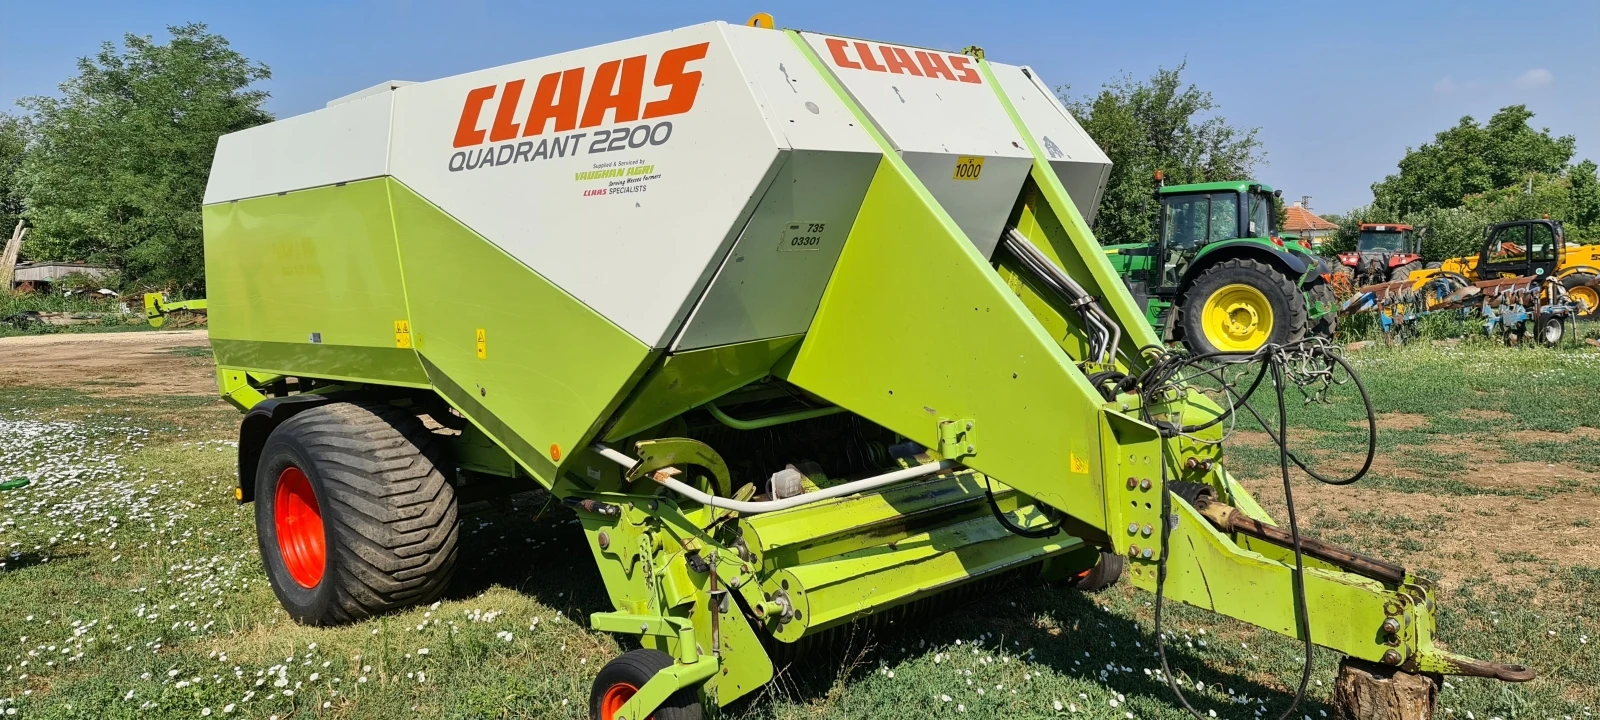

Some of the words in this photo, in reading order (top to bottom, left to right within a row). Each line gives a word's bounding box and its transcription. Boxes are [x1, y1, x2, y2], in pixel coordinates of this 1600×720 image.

[825, 38, 982, 84] CLAAS
[453, 41, 710, 148] CLAAS
[448, 133, 587, 172] QUADRANT
[588, 121, 673, 154] 2200
[575, 167, 625, 181] VAUGHAN
[626, 165, 655, 176] AGRI
[955, 163, 981, 178] 1000
[608, 179, 625, 187] Serving
[583, 188, 607, 197] CLAAS
[608, 185, 647, 195] SPECIALISTS
[807, 223, 825, 233] 735
[791, 236, 821, 246] 03301
